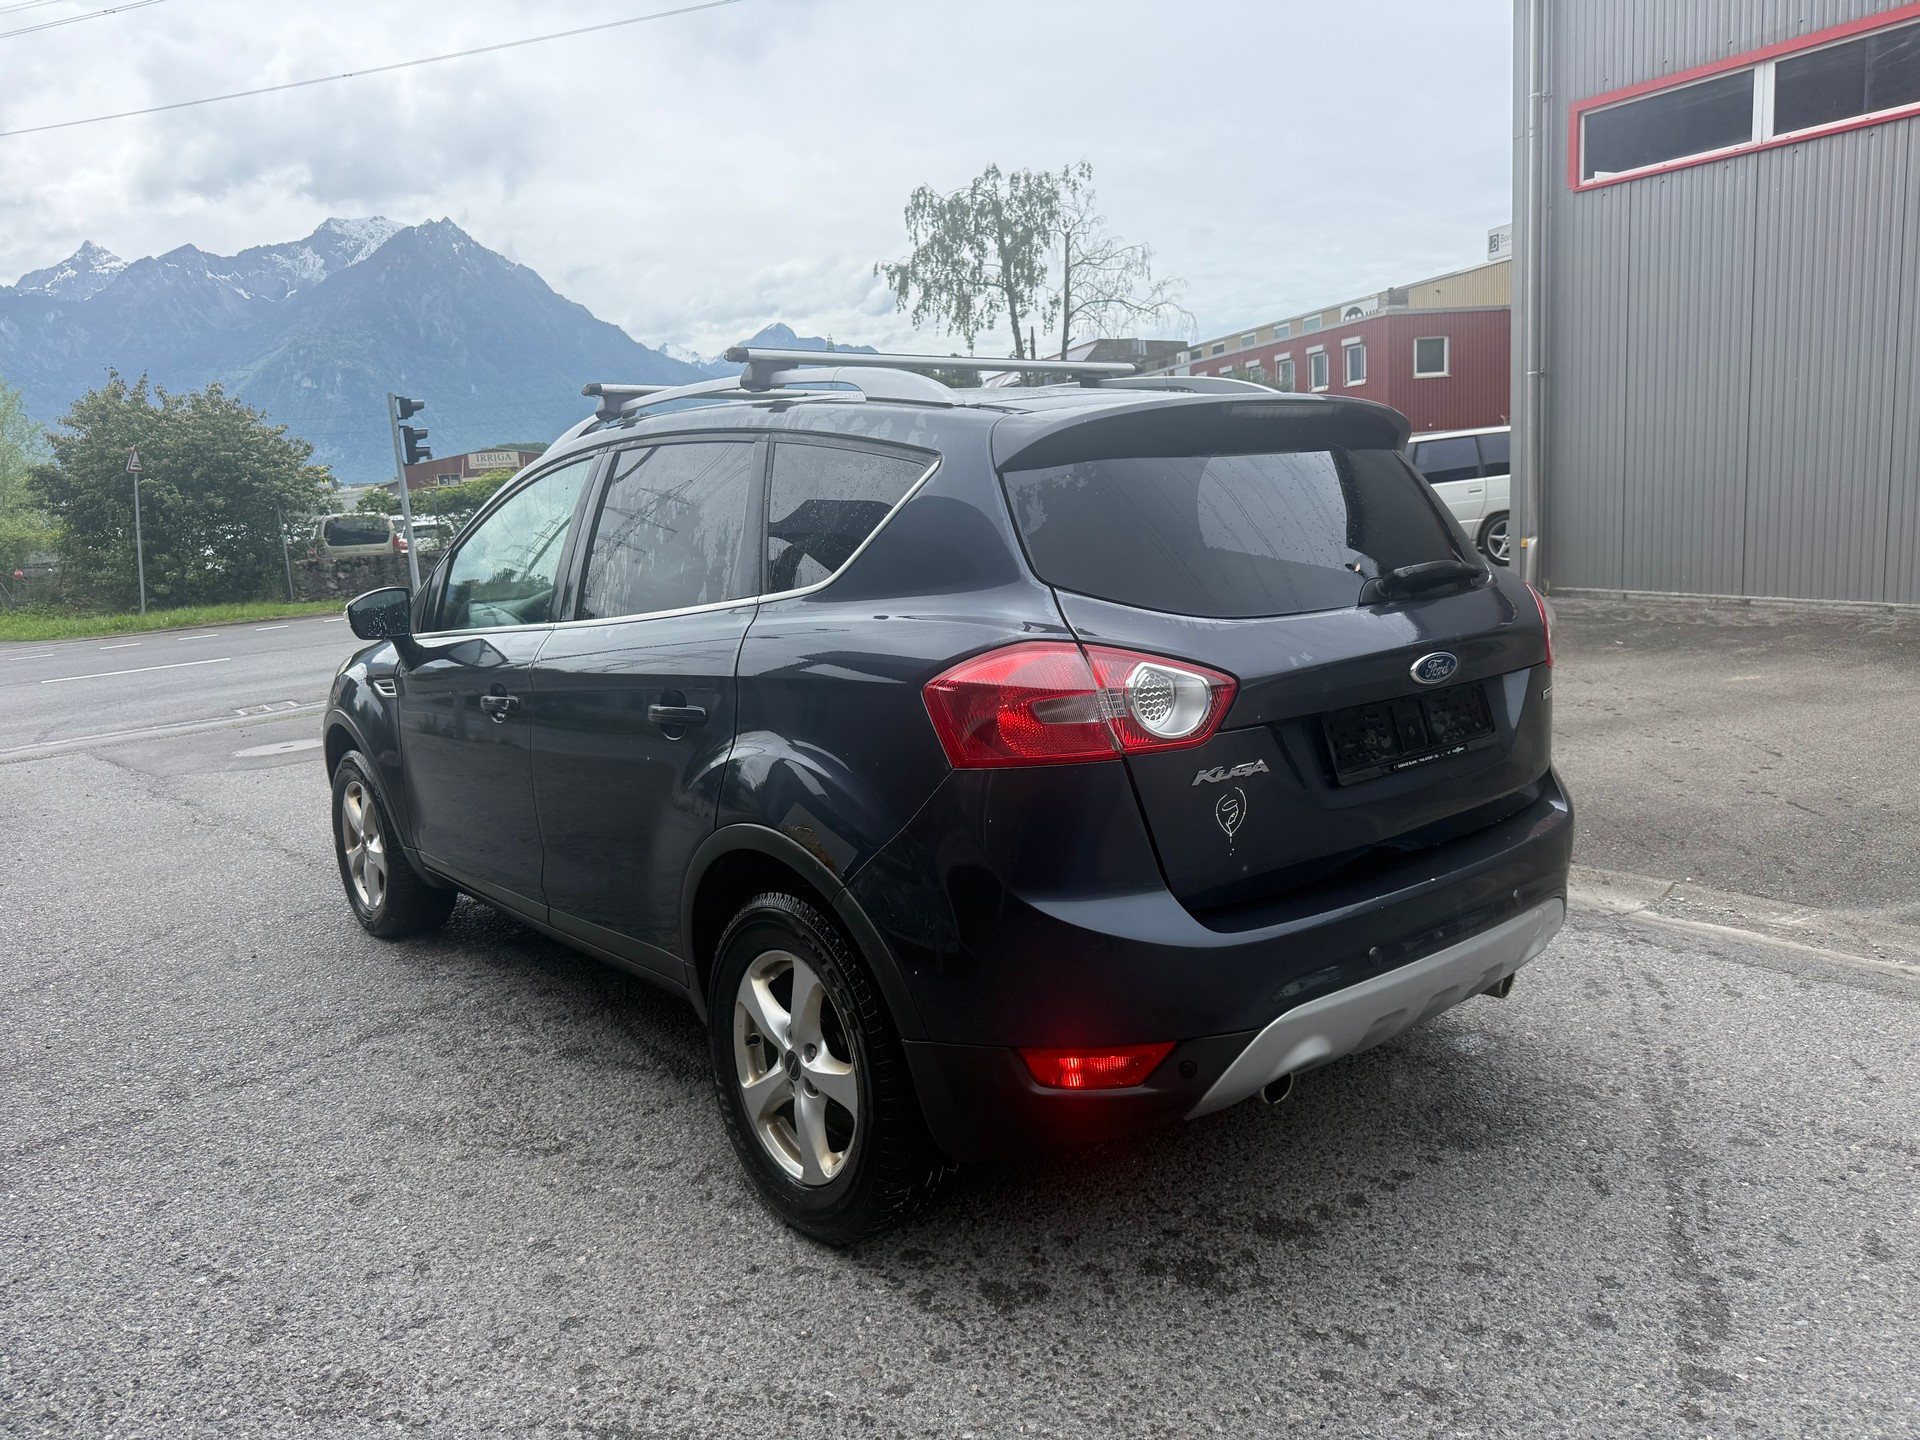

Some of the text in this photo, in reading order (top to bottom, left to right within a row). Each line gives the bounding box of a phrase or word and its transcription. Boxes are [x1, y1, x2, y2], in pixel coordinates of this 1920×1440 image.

[476, 453, 512, 463] IRRIGA
[1425, 658, 1451, 678] Ford
[1191, 758, 1270, 786] KUGA
